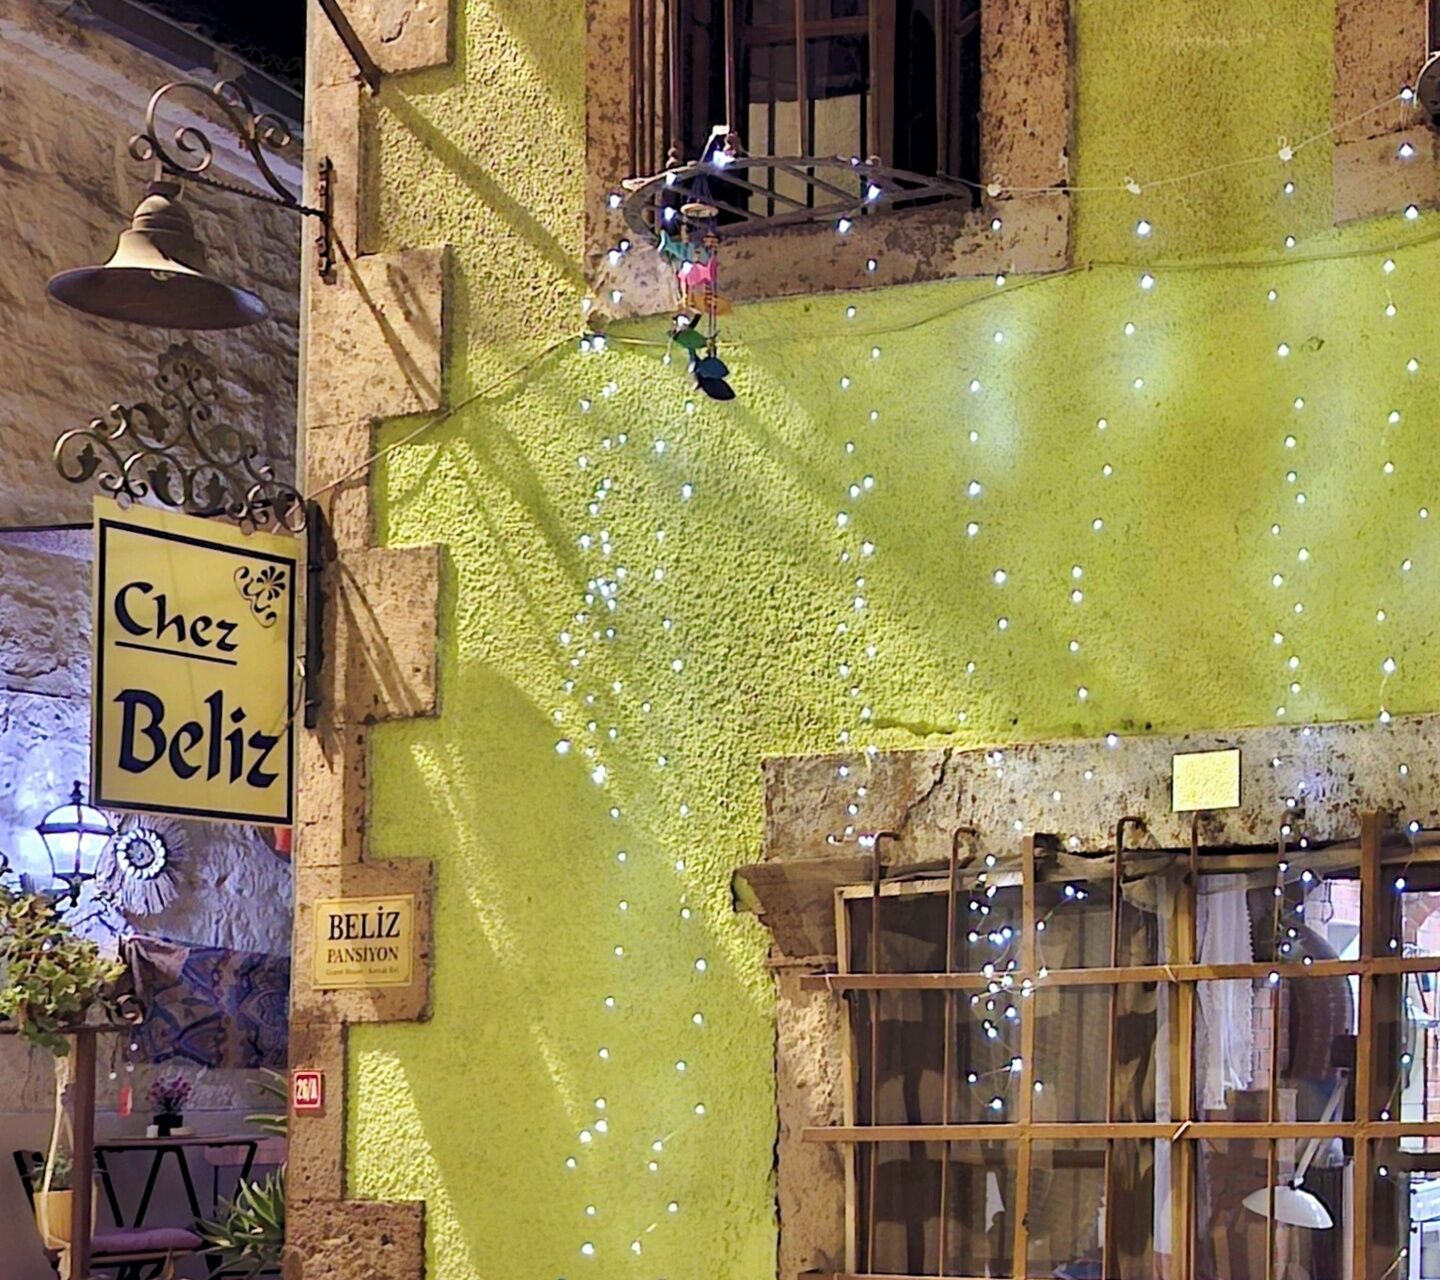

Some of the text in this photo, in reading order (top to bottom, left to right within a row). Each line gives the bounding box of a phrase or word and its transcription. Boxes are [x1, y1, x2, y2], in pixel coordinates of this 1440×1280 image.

[114, 581, 239, 652] Chez
[113, 688, 283, 789] Beliz
[328, 905, 400, 940] BELİZ
[327, 945, 399, 964] PANSİYON
